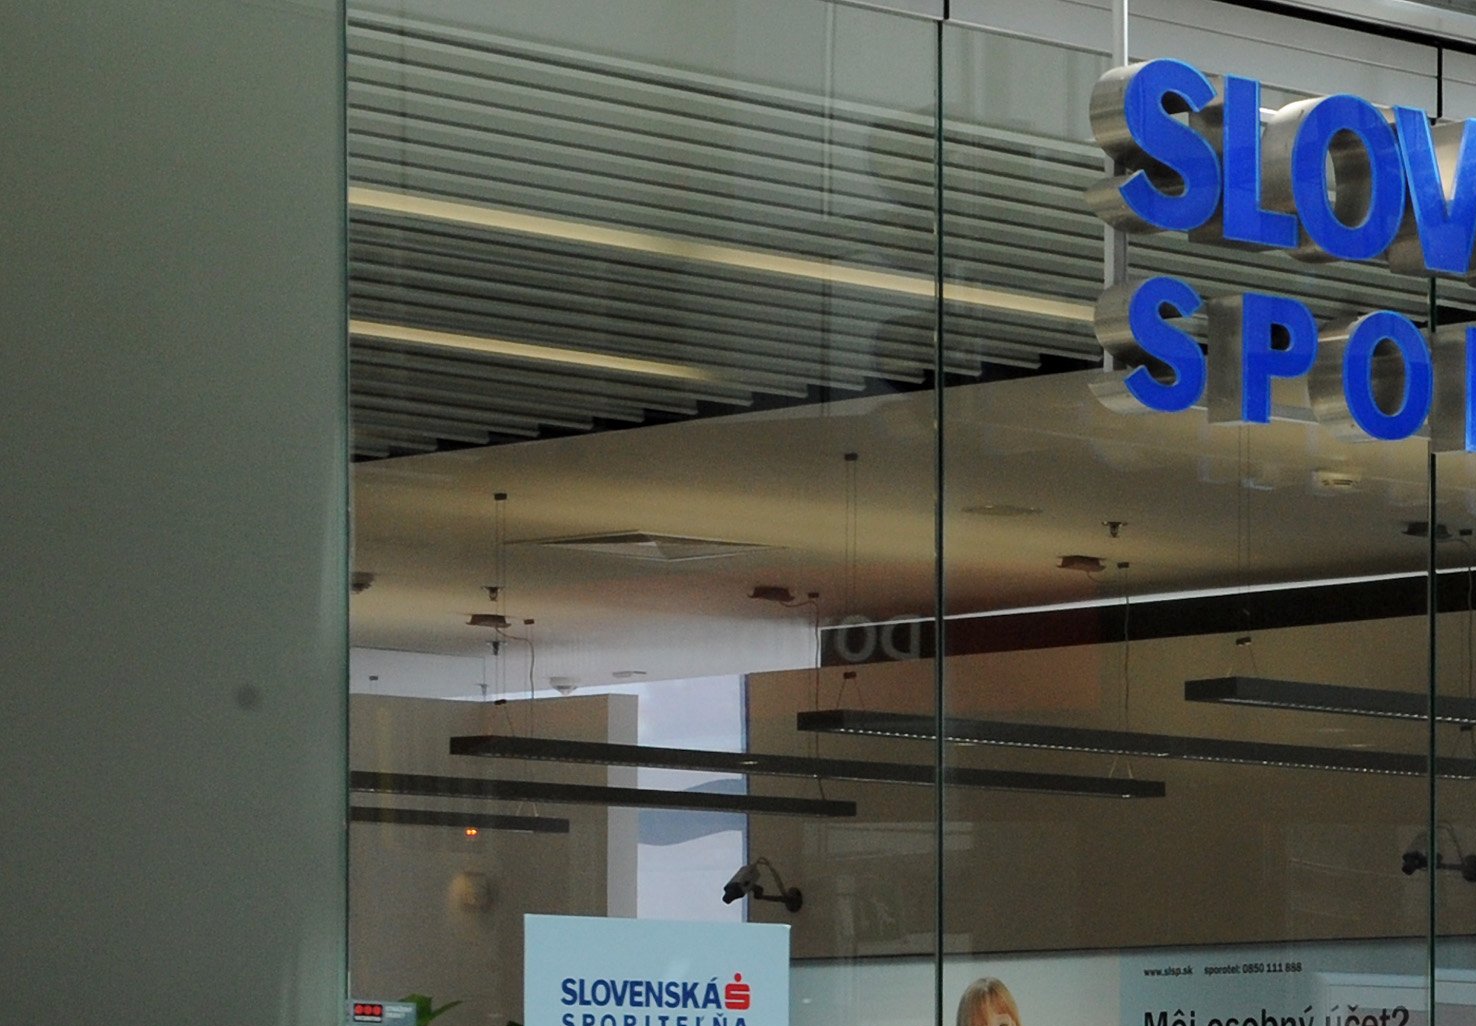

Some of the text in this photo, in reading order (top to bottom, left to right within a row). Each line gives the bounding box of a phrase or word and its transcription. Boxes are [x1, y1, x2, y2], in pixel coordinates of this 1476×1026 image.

[1144, 965, 1193, 977] www.slsp.sk
[1242, 962, 1264, 974] 0850
[1266, 962, 1283, 973] 111
[1285, 961, 1302, 972] 888
[561, 977, 722, 1010] SLOVENSKÁ
